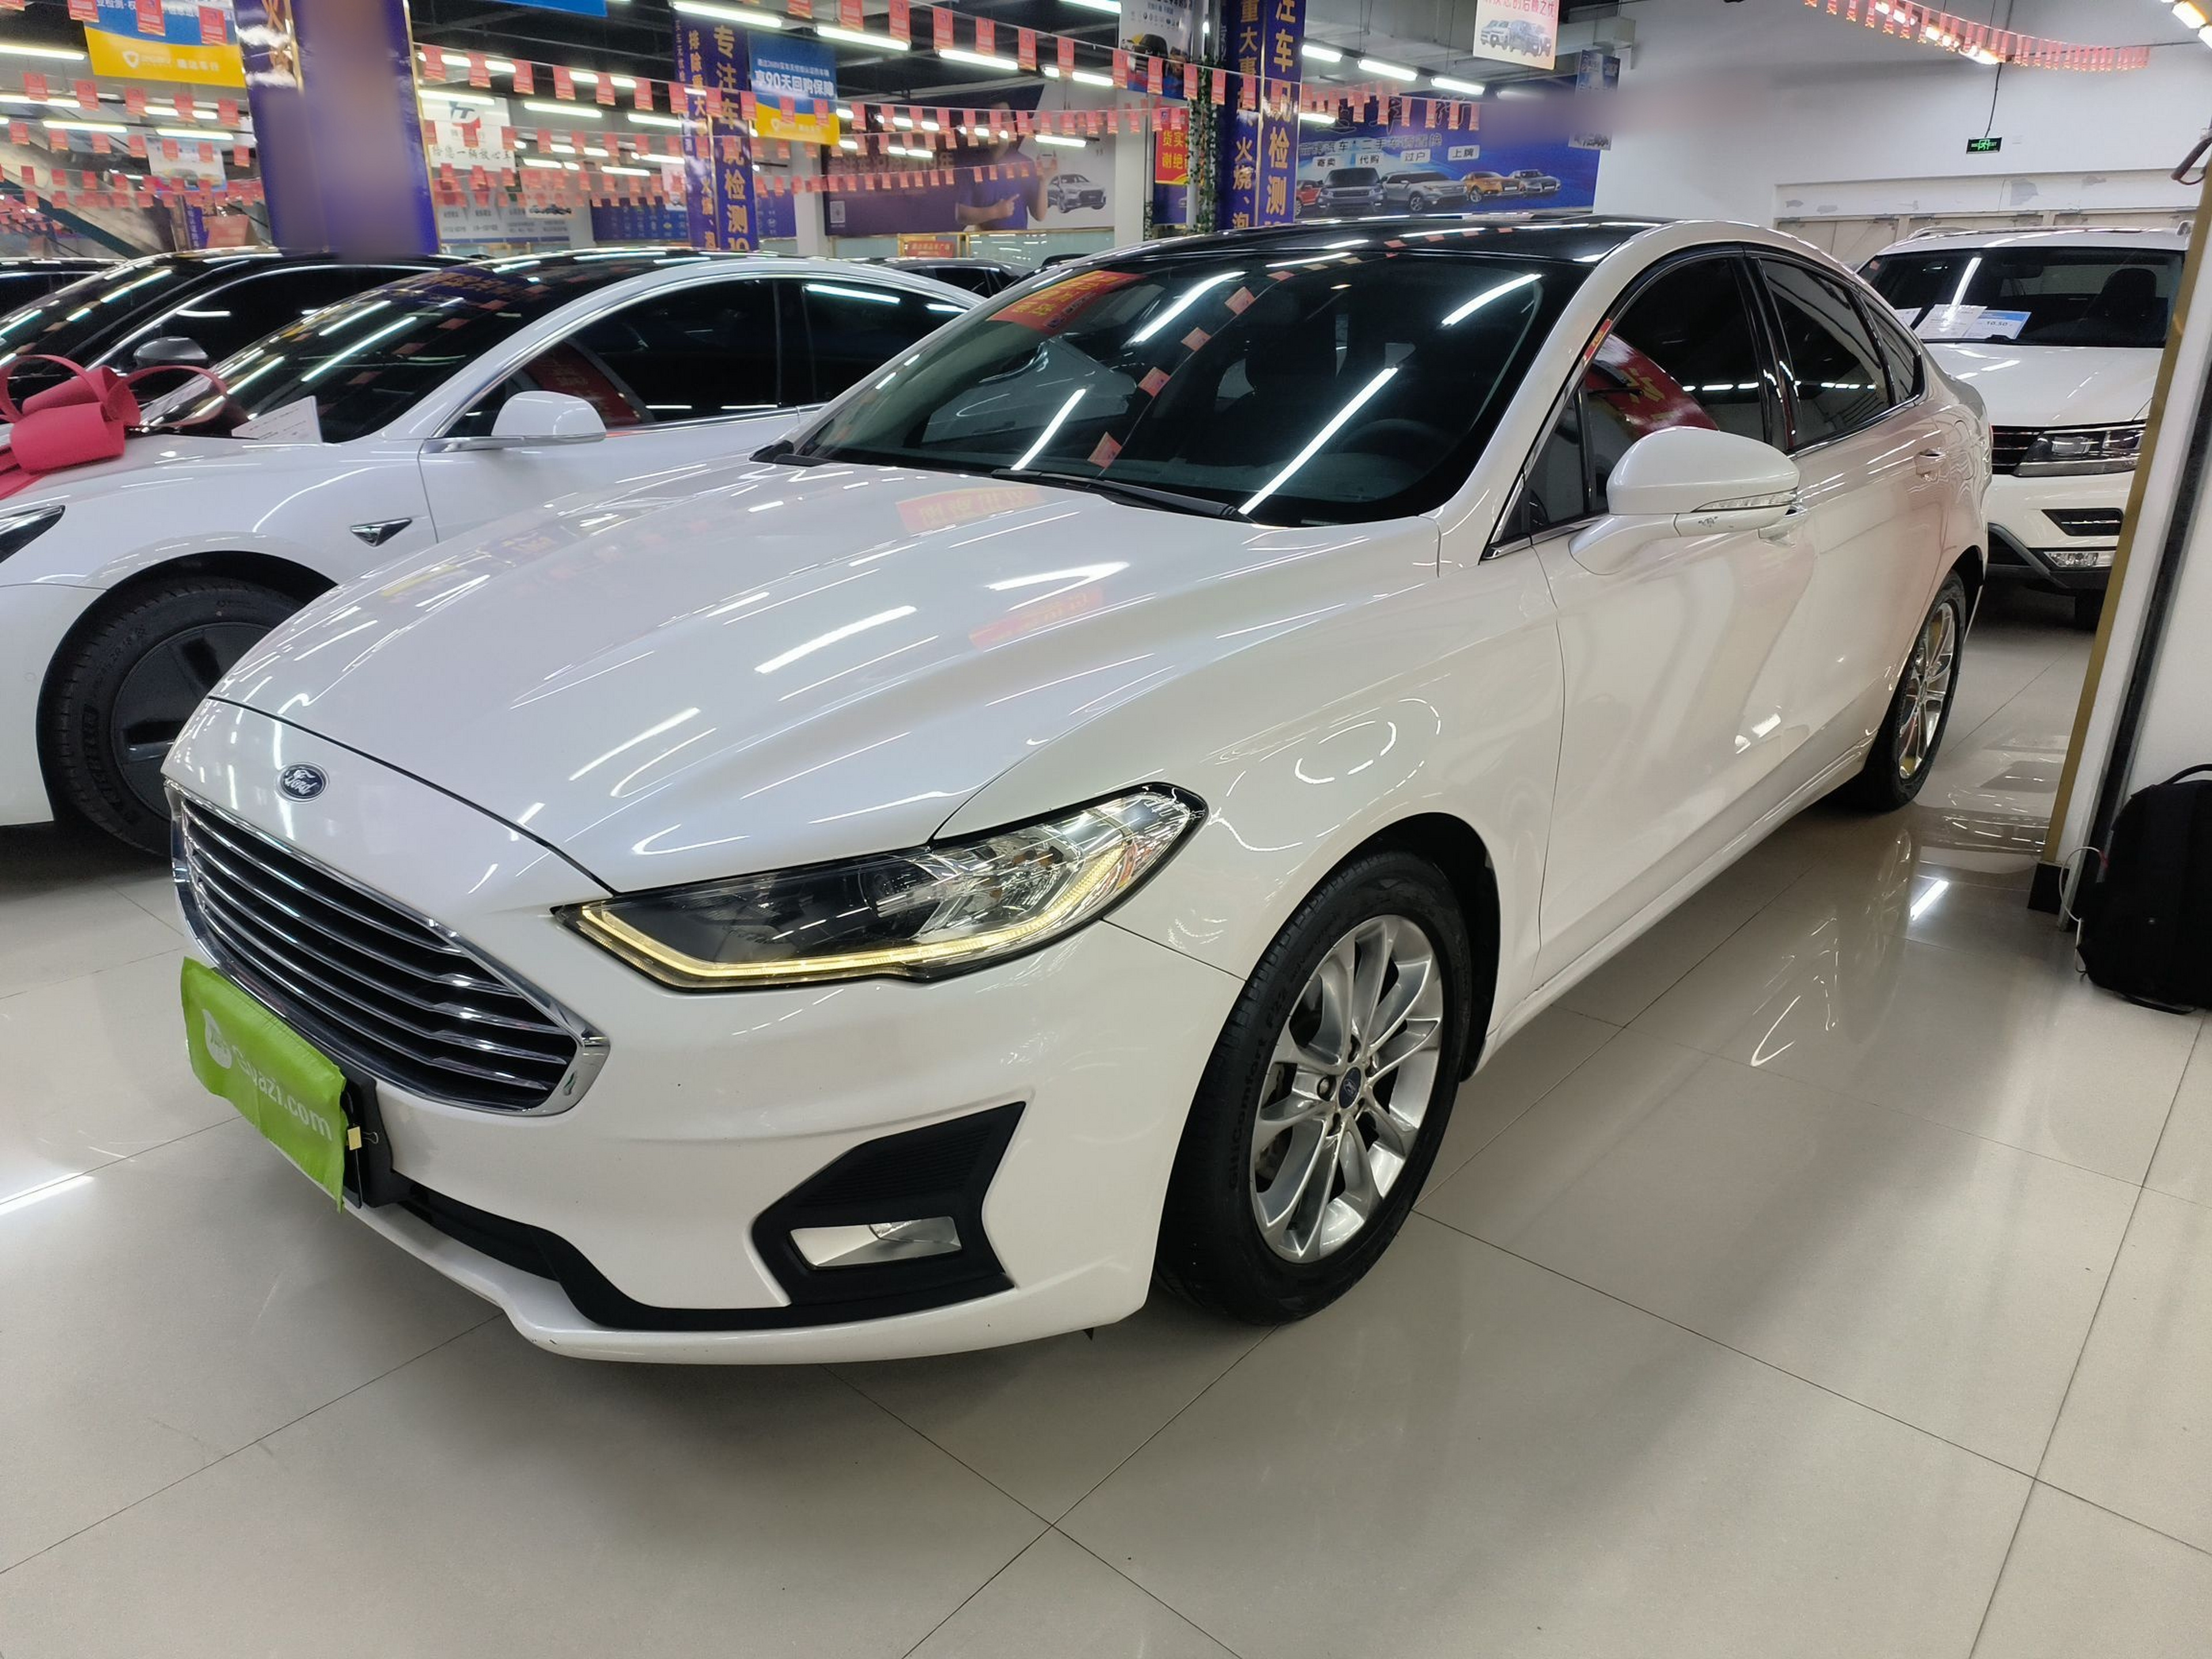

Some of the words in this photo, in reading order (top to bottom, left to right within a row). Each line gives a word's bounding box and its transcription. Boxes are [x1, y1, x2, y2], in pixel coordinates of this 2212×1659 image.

[1404, 151, 1426, 162] 过户
[1452, 147, 1475, 158] 上牌
[1359, 155, 1380, 165] 代购
[285, 770, 317, 795] Ford
